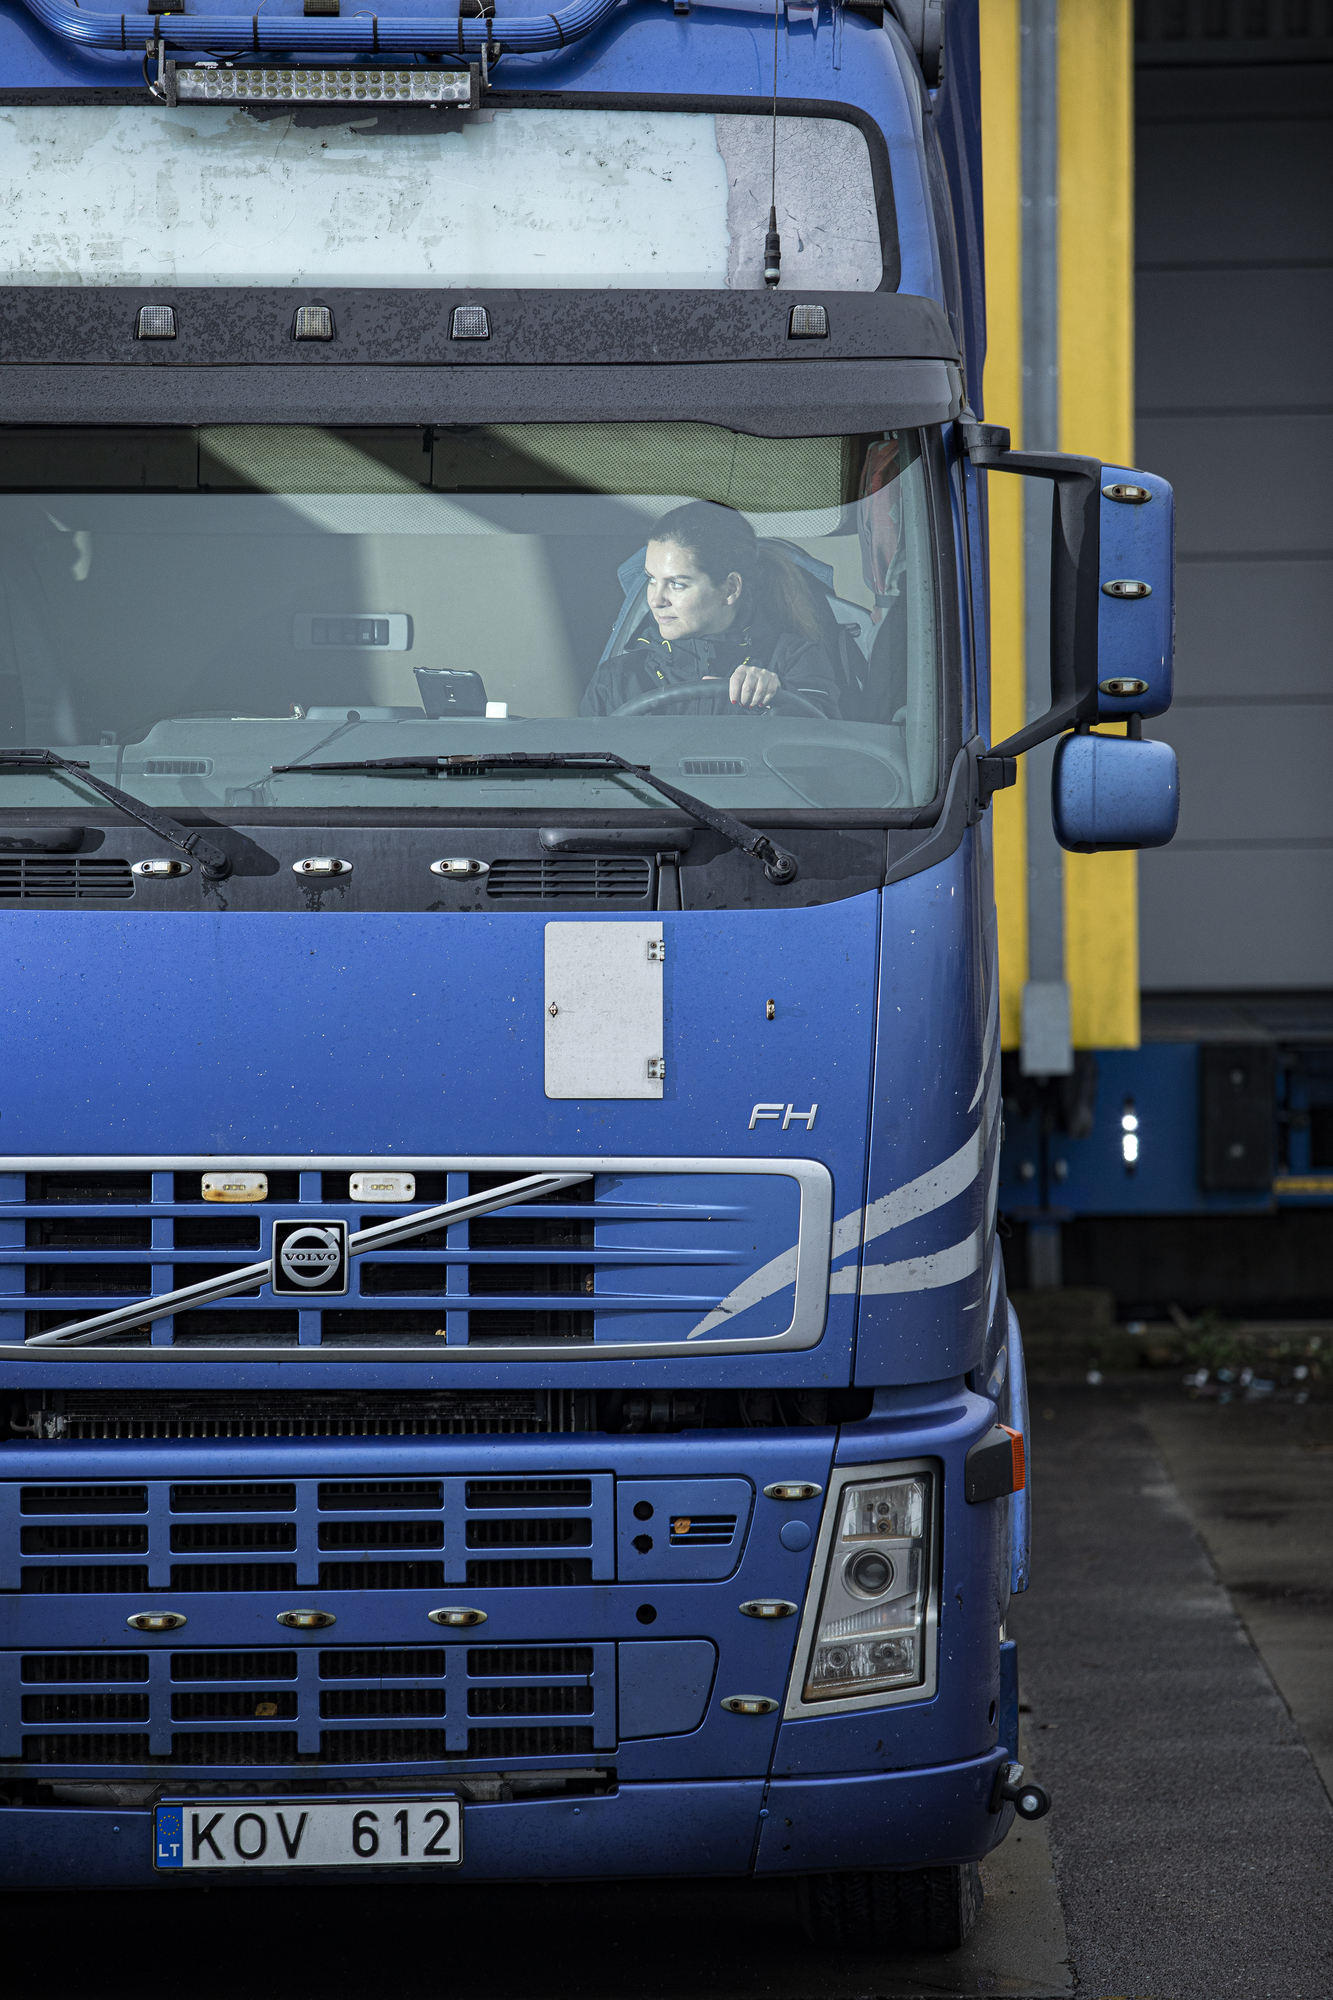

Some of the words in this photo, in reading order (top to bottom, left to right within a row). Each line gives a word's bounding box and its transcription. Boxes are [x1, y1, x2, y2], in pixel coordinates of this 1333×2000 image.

[748, 1103, 819, 1130] FH
[283, 1253, 338, 1261] VOLVO
[191, 1811, 309, 1860] KOV
[352, 1808, 451, 1858] 612
[158, 1843, 180, 1858] LT
